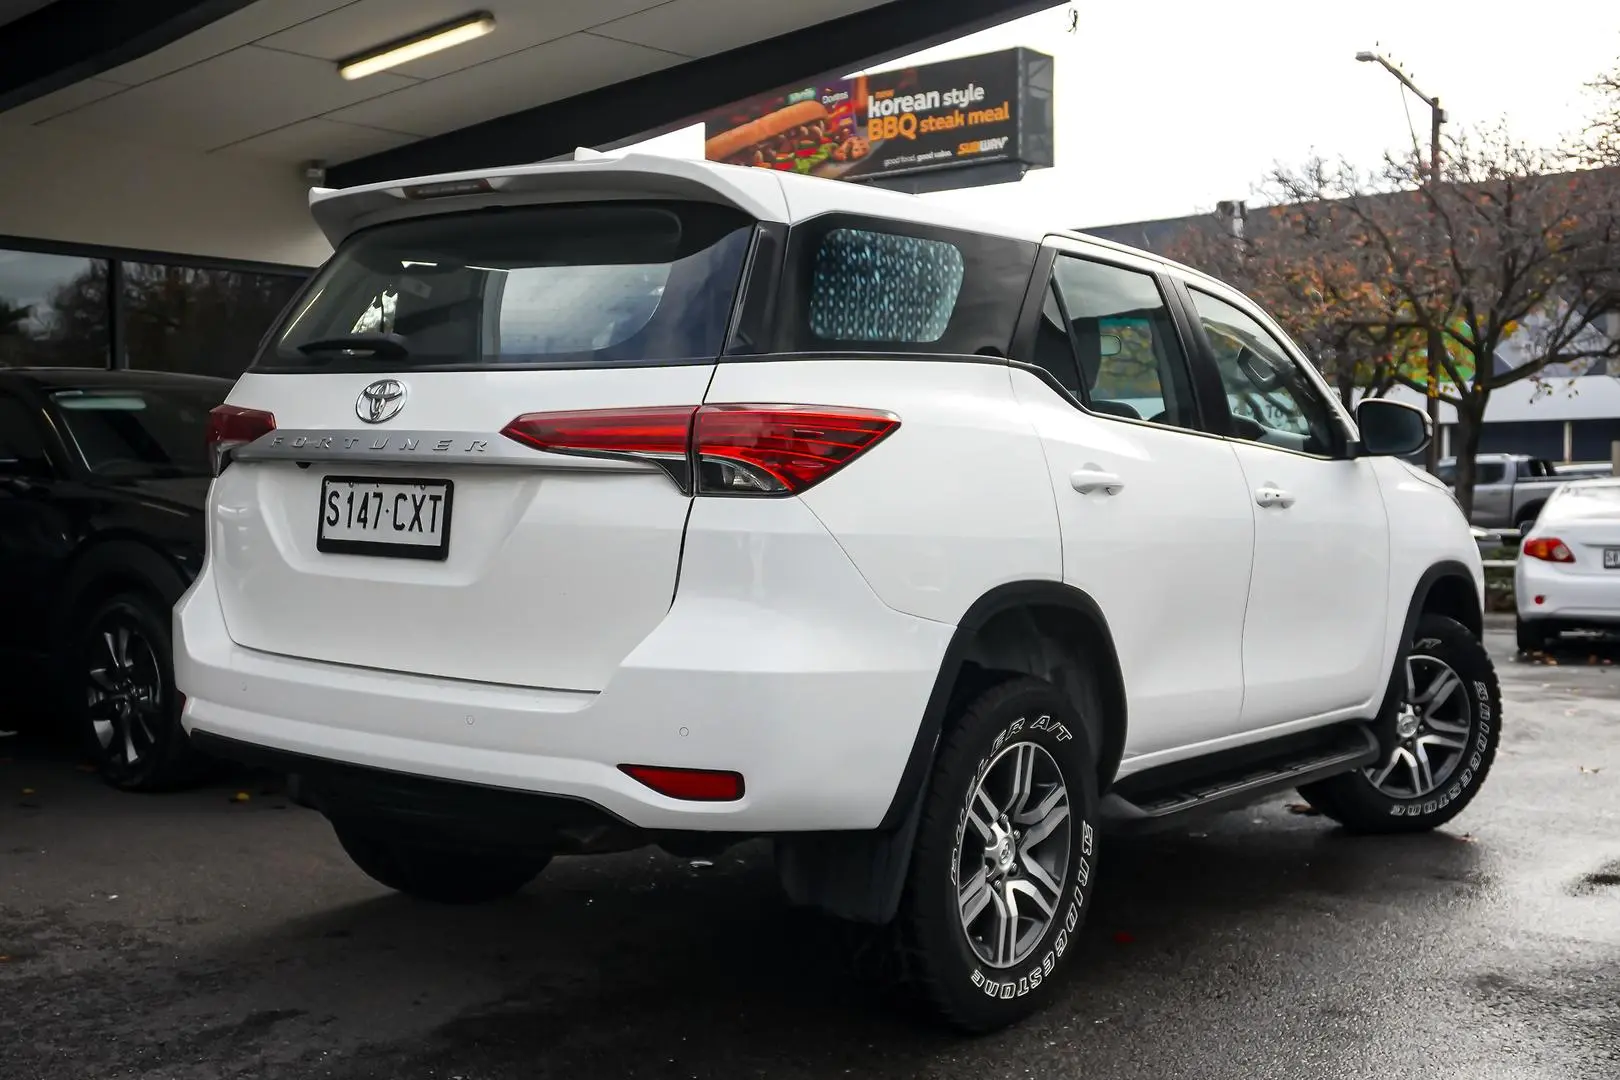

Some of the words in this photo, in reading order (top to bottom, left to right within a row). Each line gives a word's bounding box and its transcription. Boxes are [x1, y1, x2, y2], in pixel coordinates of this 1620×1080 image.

[867, 90, 940, 118] korean
[943, 83, 985, 108] style
[867, 113, 918, 141] BBQ
[920, 109, 965, 133] steak
[968, 101, 1010, 125] meal
[270, 436, 488, 452] FORTUNER
[1033, 715, 1072, 742] A/T
[1390, 680, 1491, 816] BRIDGESTONE
[971, 820, 1095, 999] BRIDGESTONE
